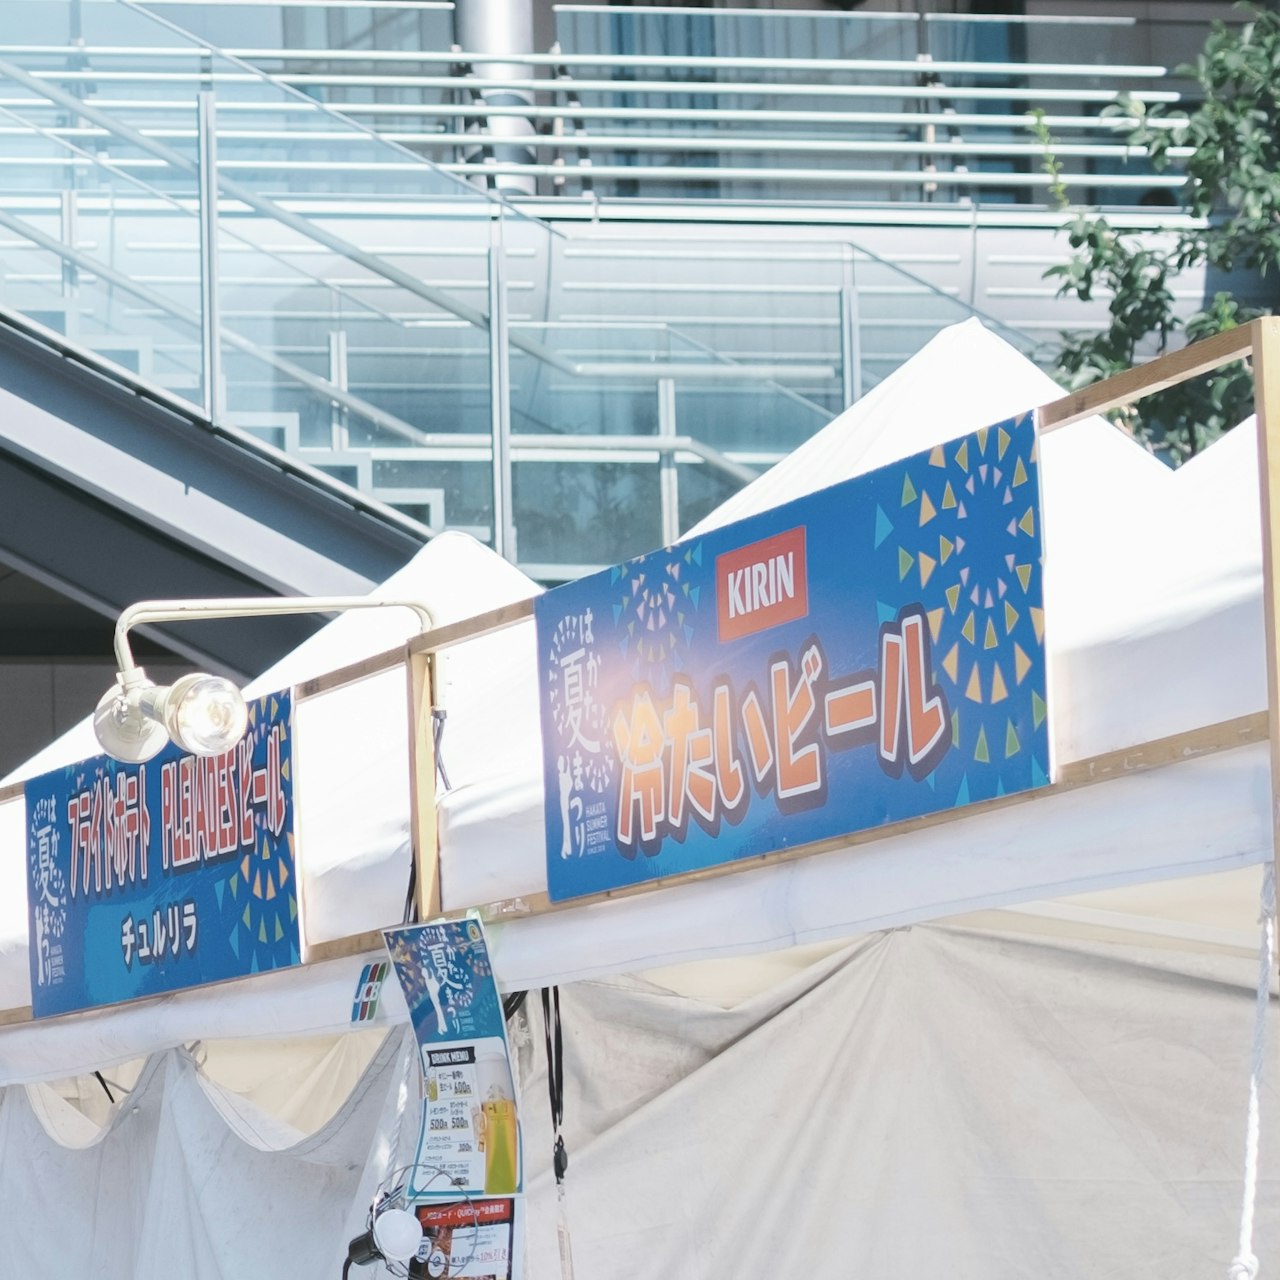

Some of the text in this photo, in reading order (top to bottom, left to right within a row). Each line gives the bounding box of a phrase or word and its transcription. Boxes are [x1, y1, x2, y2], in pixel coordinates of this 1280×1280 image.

[728, 552, 794, 619] KIRIN
[613, 614, 944, 845] 冷たいビール
[121, 903, 198, 966] チュルリラ
[451, 1050, 470, 1062] MENU
